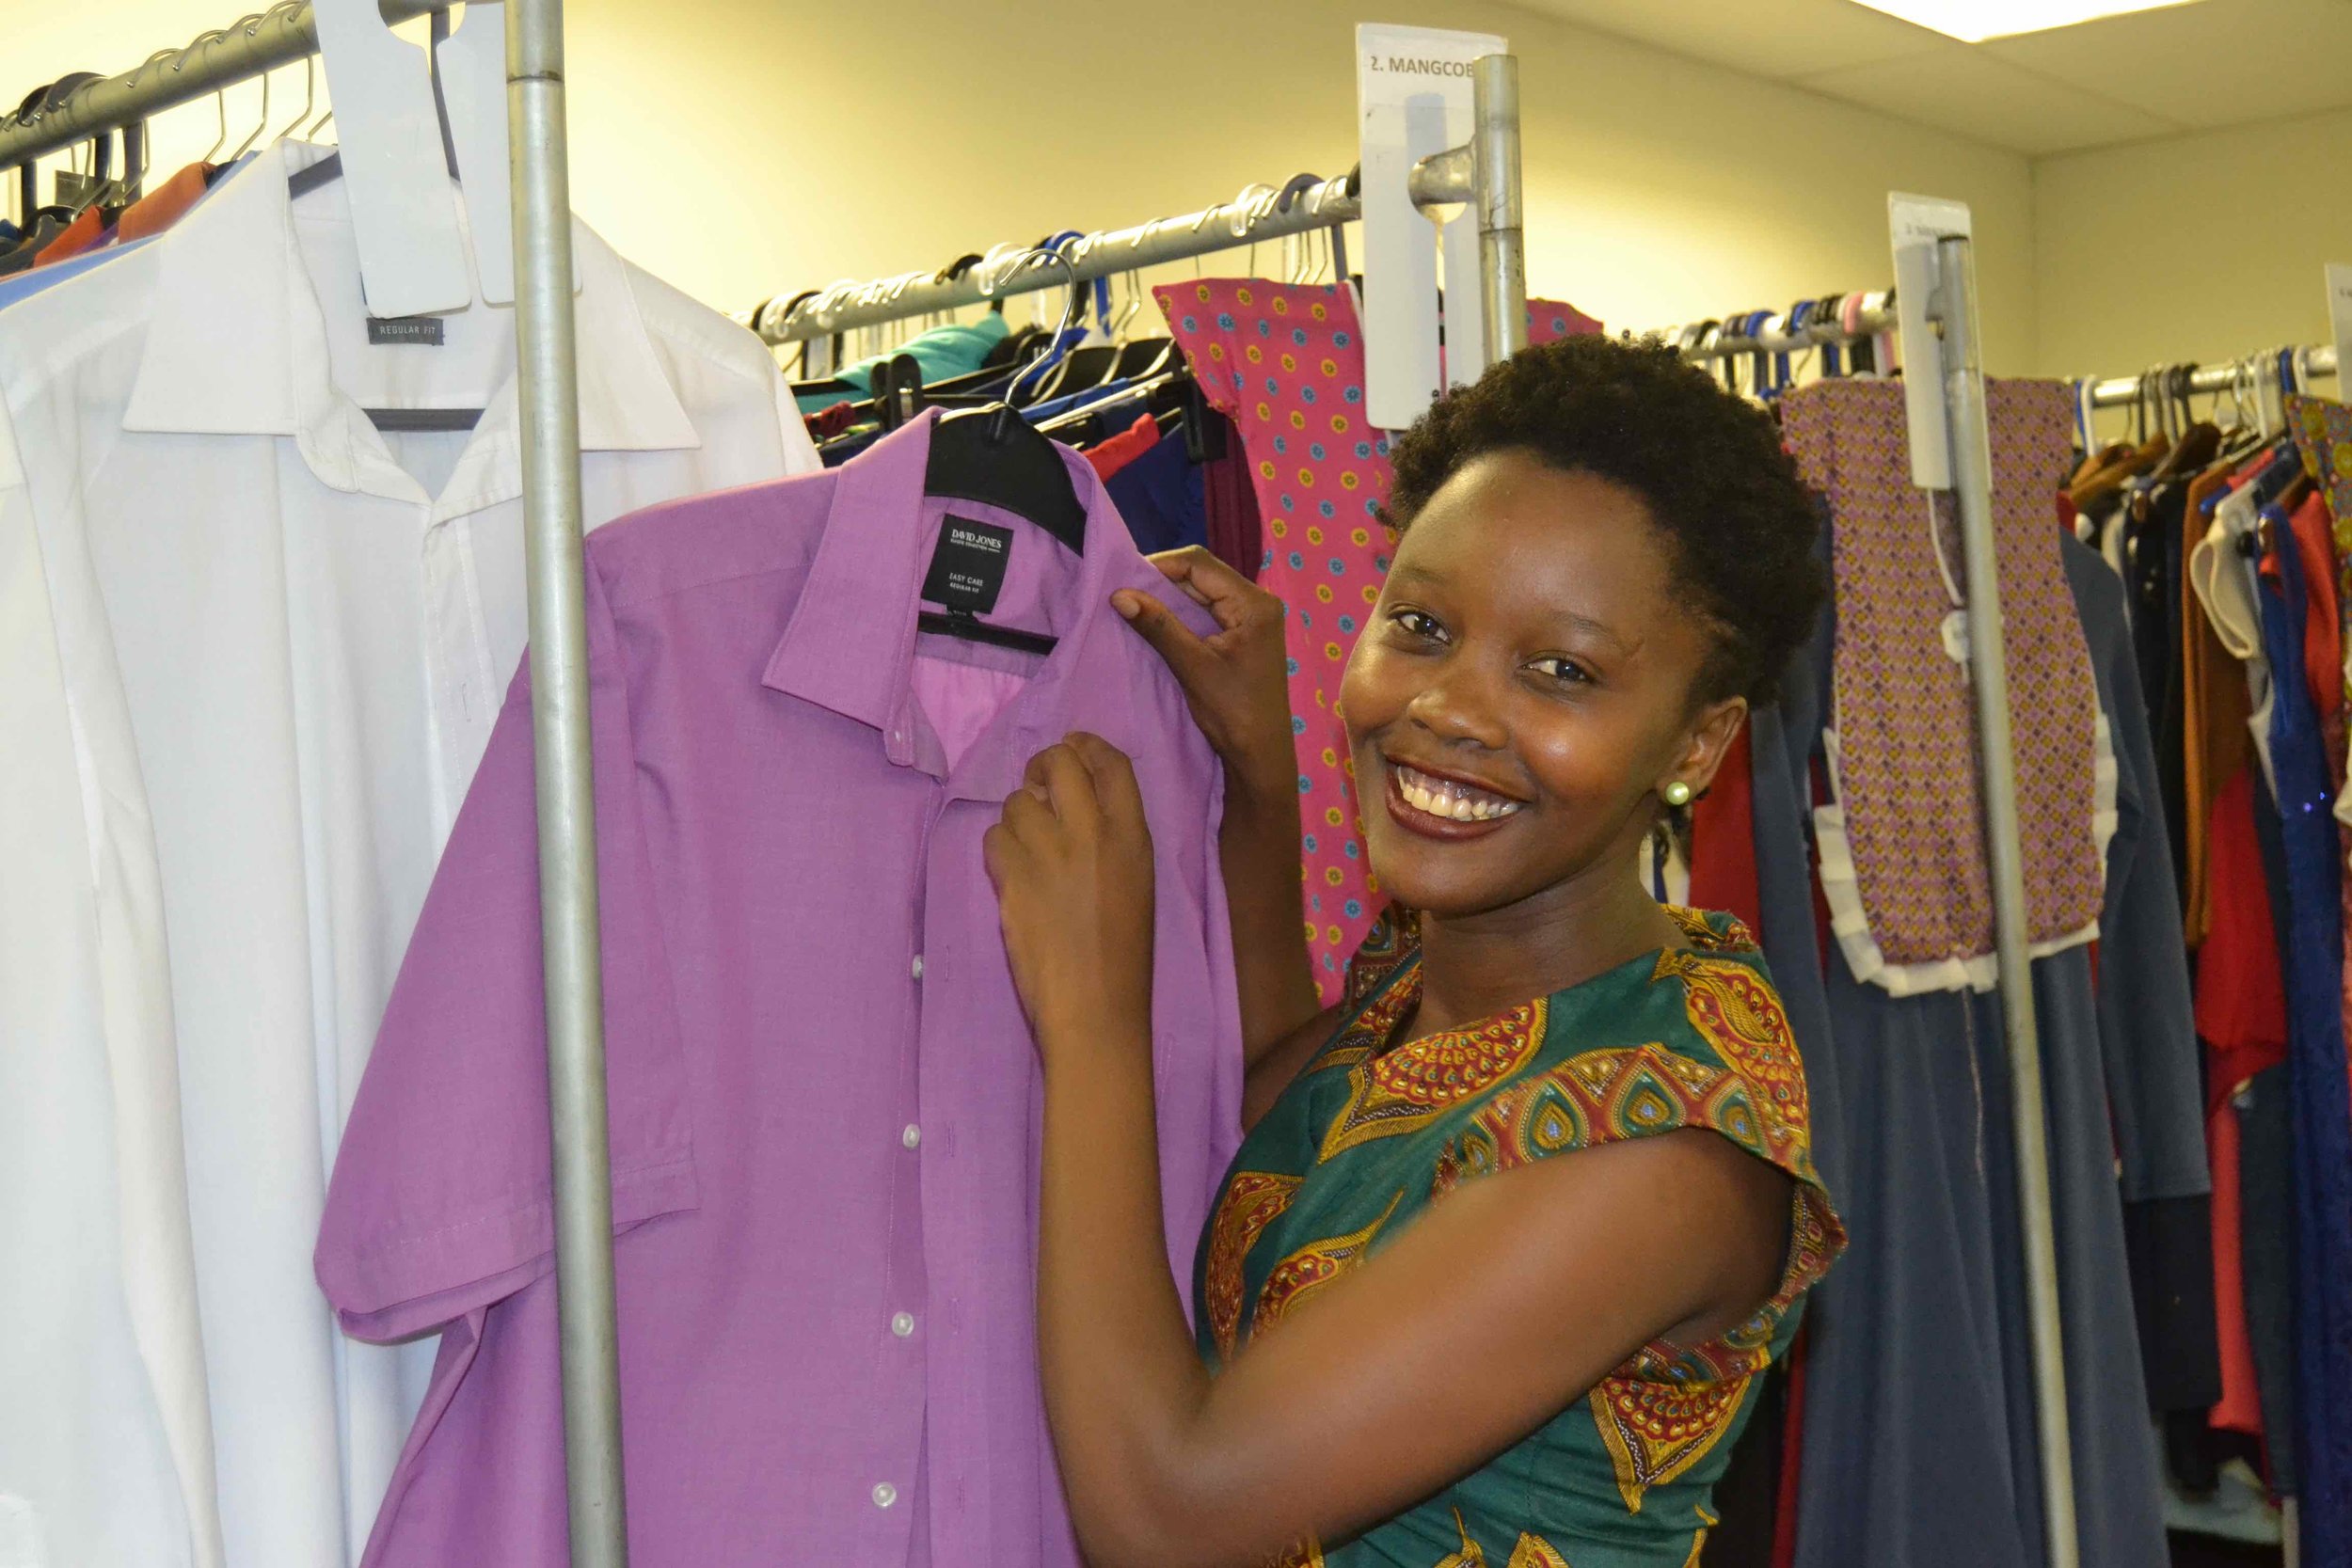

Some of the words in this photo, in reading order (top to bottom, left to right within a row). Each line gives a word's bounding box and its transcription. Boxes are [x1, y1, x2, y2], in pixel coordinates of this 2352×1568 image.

[1371, 55, 1384, 71] 2.
[380, 325, 420, 336] REGULAR
[423, 325, 436, 335] FIT
[952, 529, 976, 542] DAVID
[976, 534, 1002, 548] JONES
[949, 572, 966, 582] EASY
[966, 577, 983, 587] CARE
